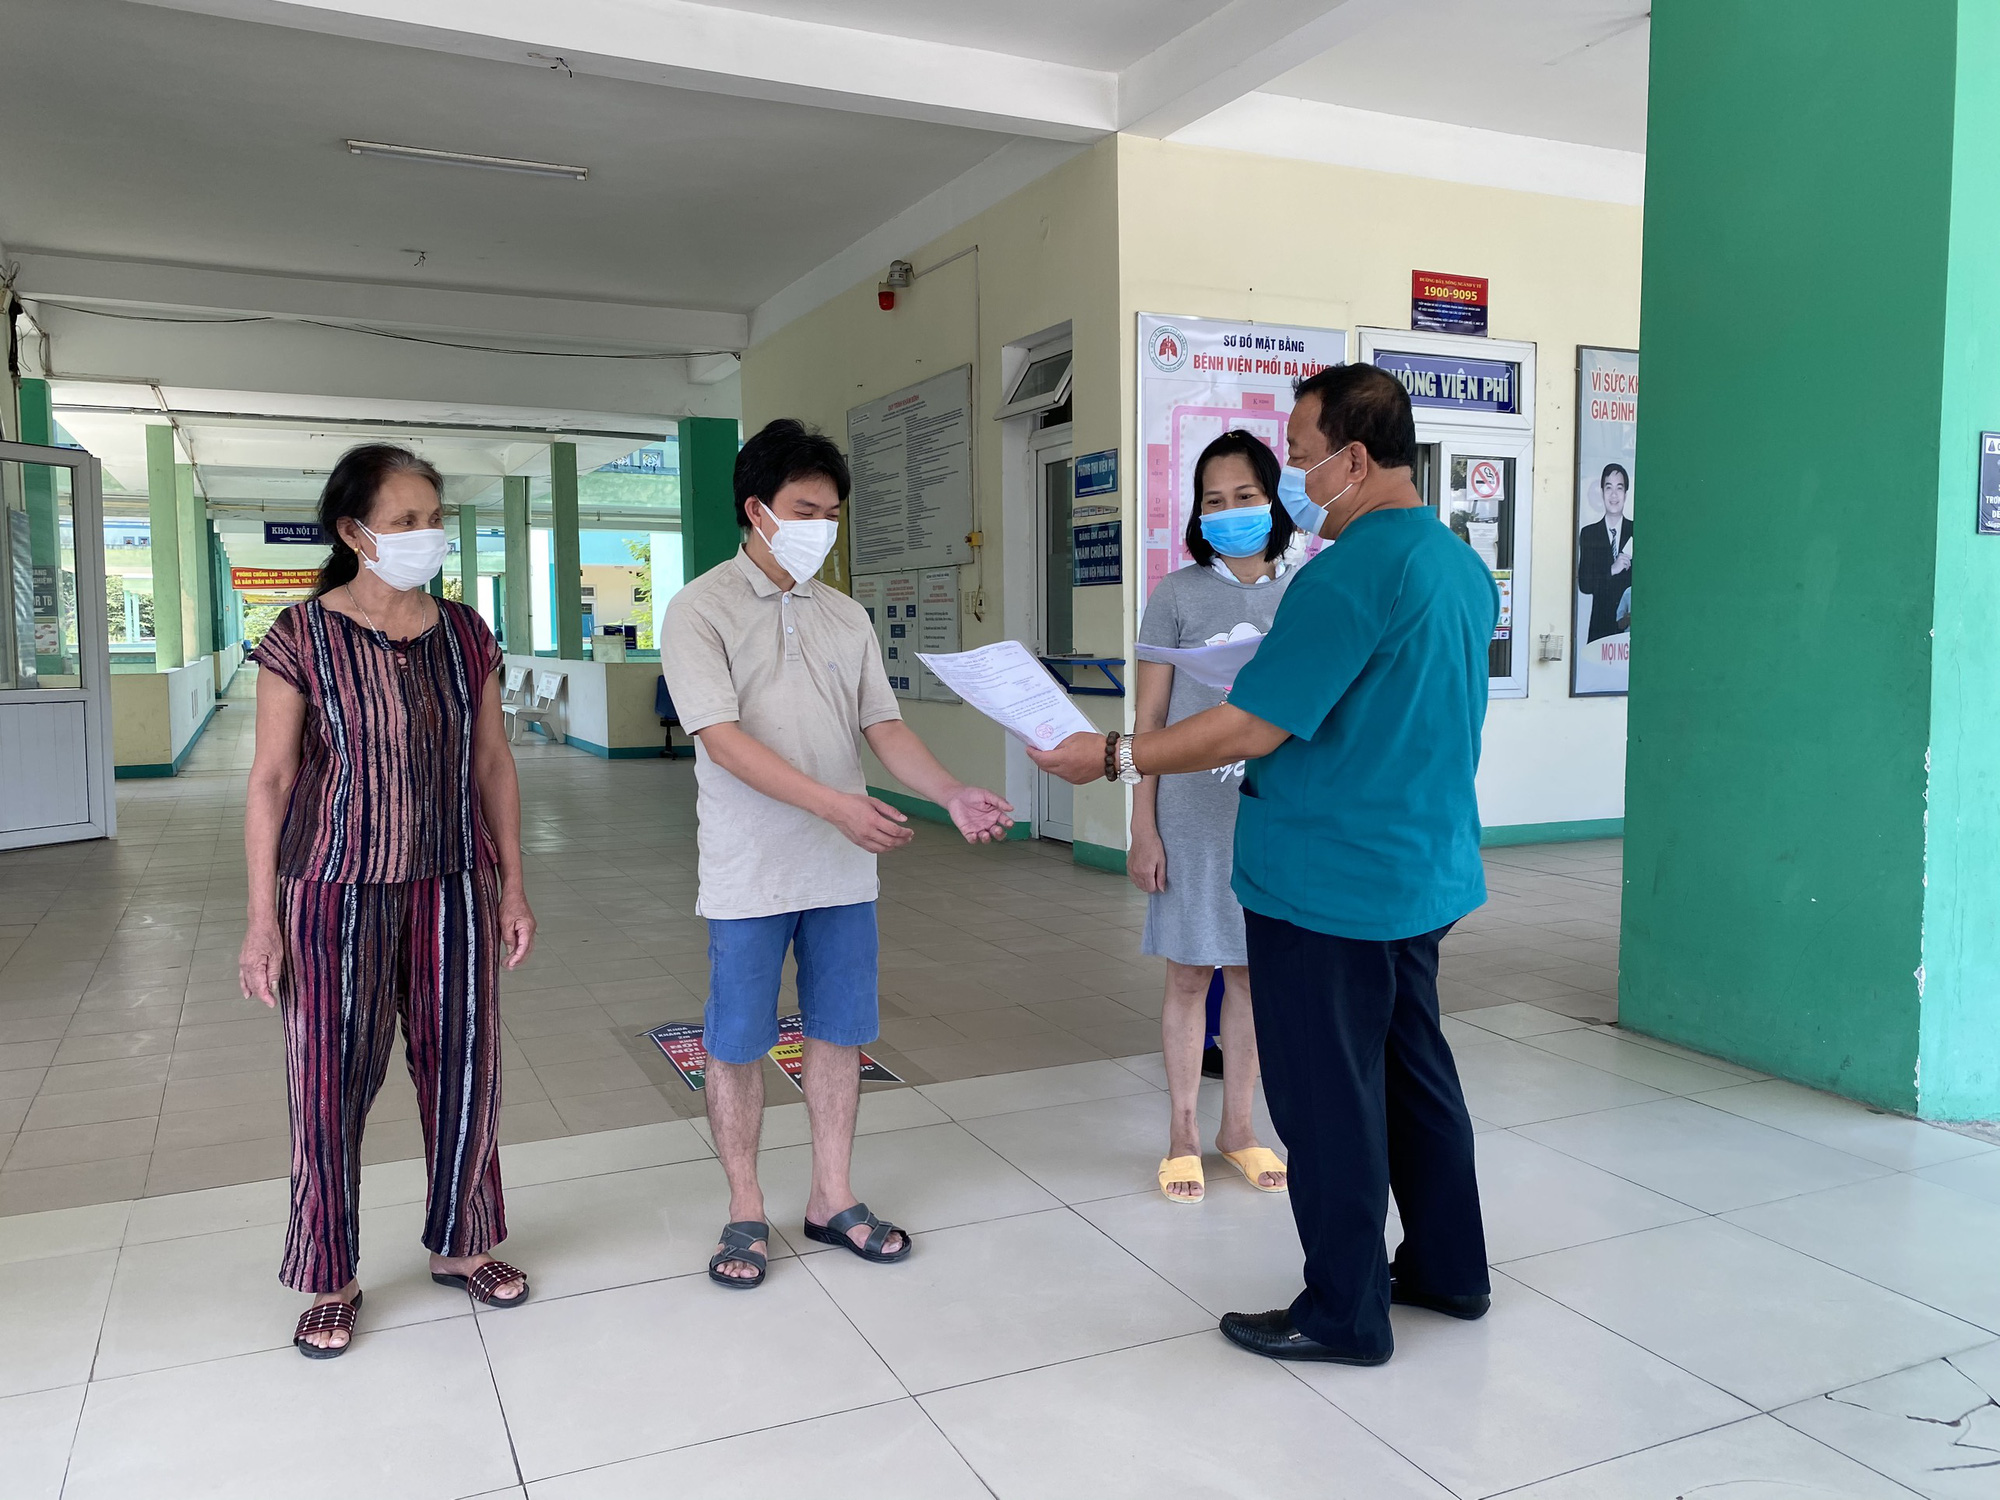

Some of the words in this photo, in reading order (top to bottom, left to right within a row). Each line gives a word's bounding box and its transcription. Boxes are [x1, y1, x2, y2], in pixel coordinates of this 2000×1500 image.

[1424, 286, 1478, 301] 1900-9095
[1223, 334, 1237, 348] SƠ
[1239, 334, 1253, 348] ĐỒ
[1255, 338, 1276, 352] MẶT
[1278, 336, 1305, 352] BẰNG
[1193, 354, 1224, 373] BỆNH
[1227, 355, 1252, 375] VIỆN
[1255, 355, 1282, 375] PHỔI
[1284, 358, 1298, 376] ĐÀ
[1441, 368, 1478, 404] VIỆN
[1483, 372, 1510, 402] PHÍ
[1592, 367, 1601, 391] VÌ
[1604, 368, 1625, 393] SỨC
[1592, 400, 1608, 420] GIA
[1611, 397, 1634, 421] ĐÌNH
[296, 526, 310, 536] NỘI
[1075, 545, 1089, 560] KHÁM
[1091, 543, 1104, 559] CHỮA
[1105, 542, 1119, 560] BỆNH
[1602, 643, 1616, 665] MỌI
[1618, 643, 1629, 660] NG
